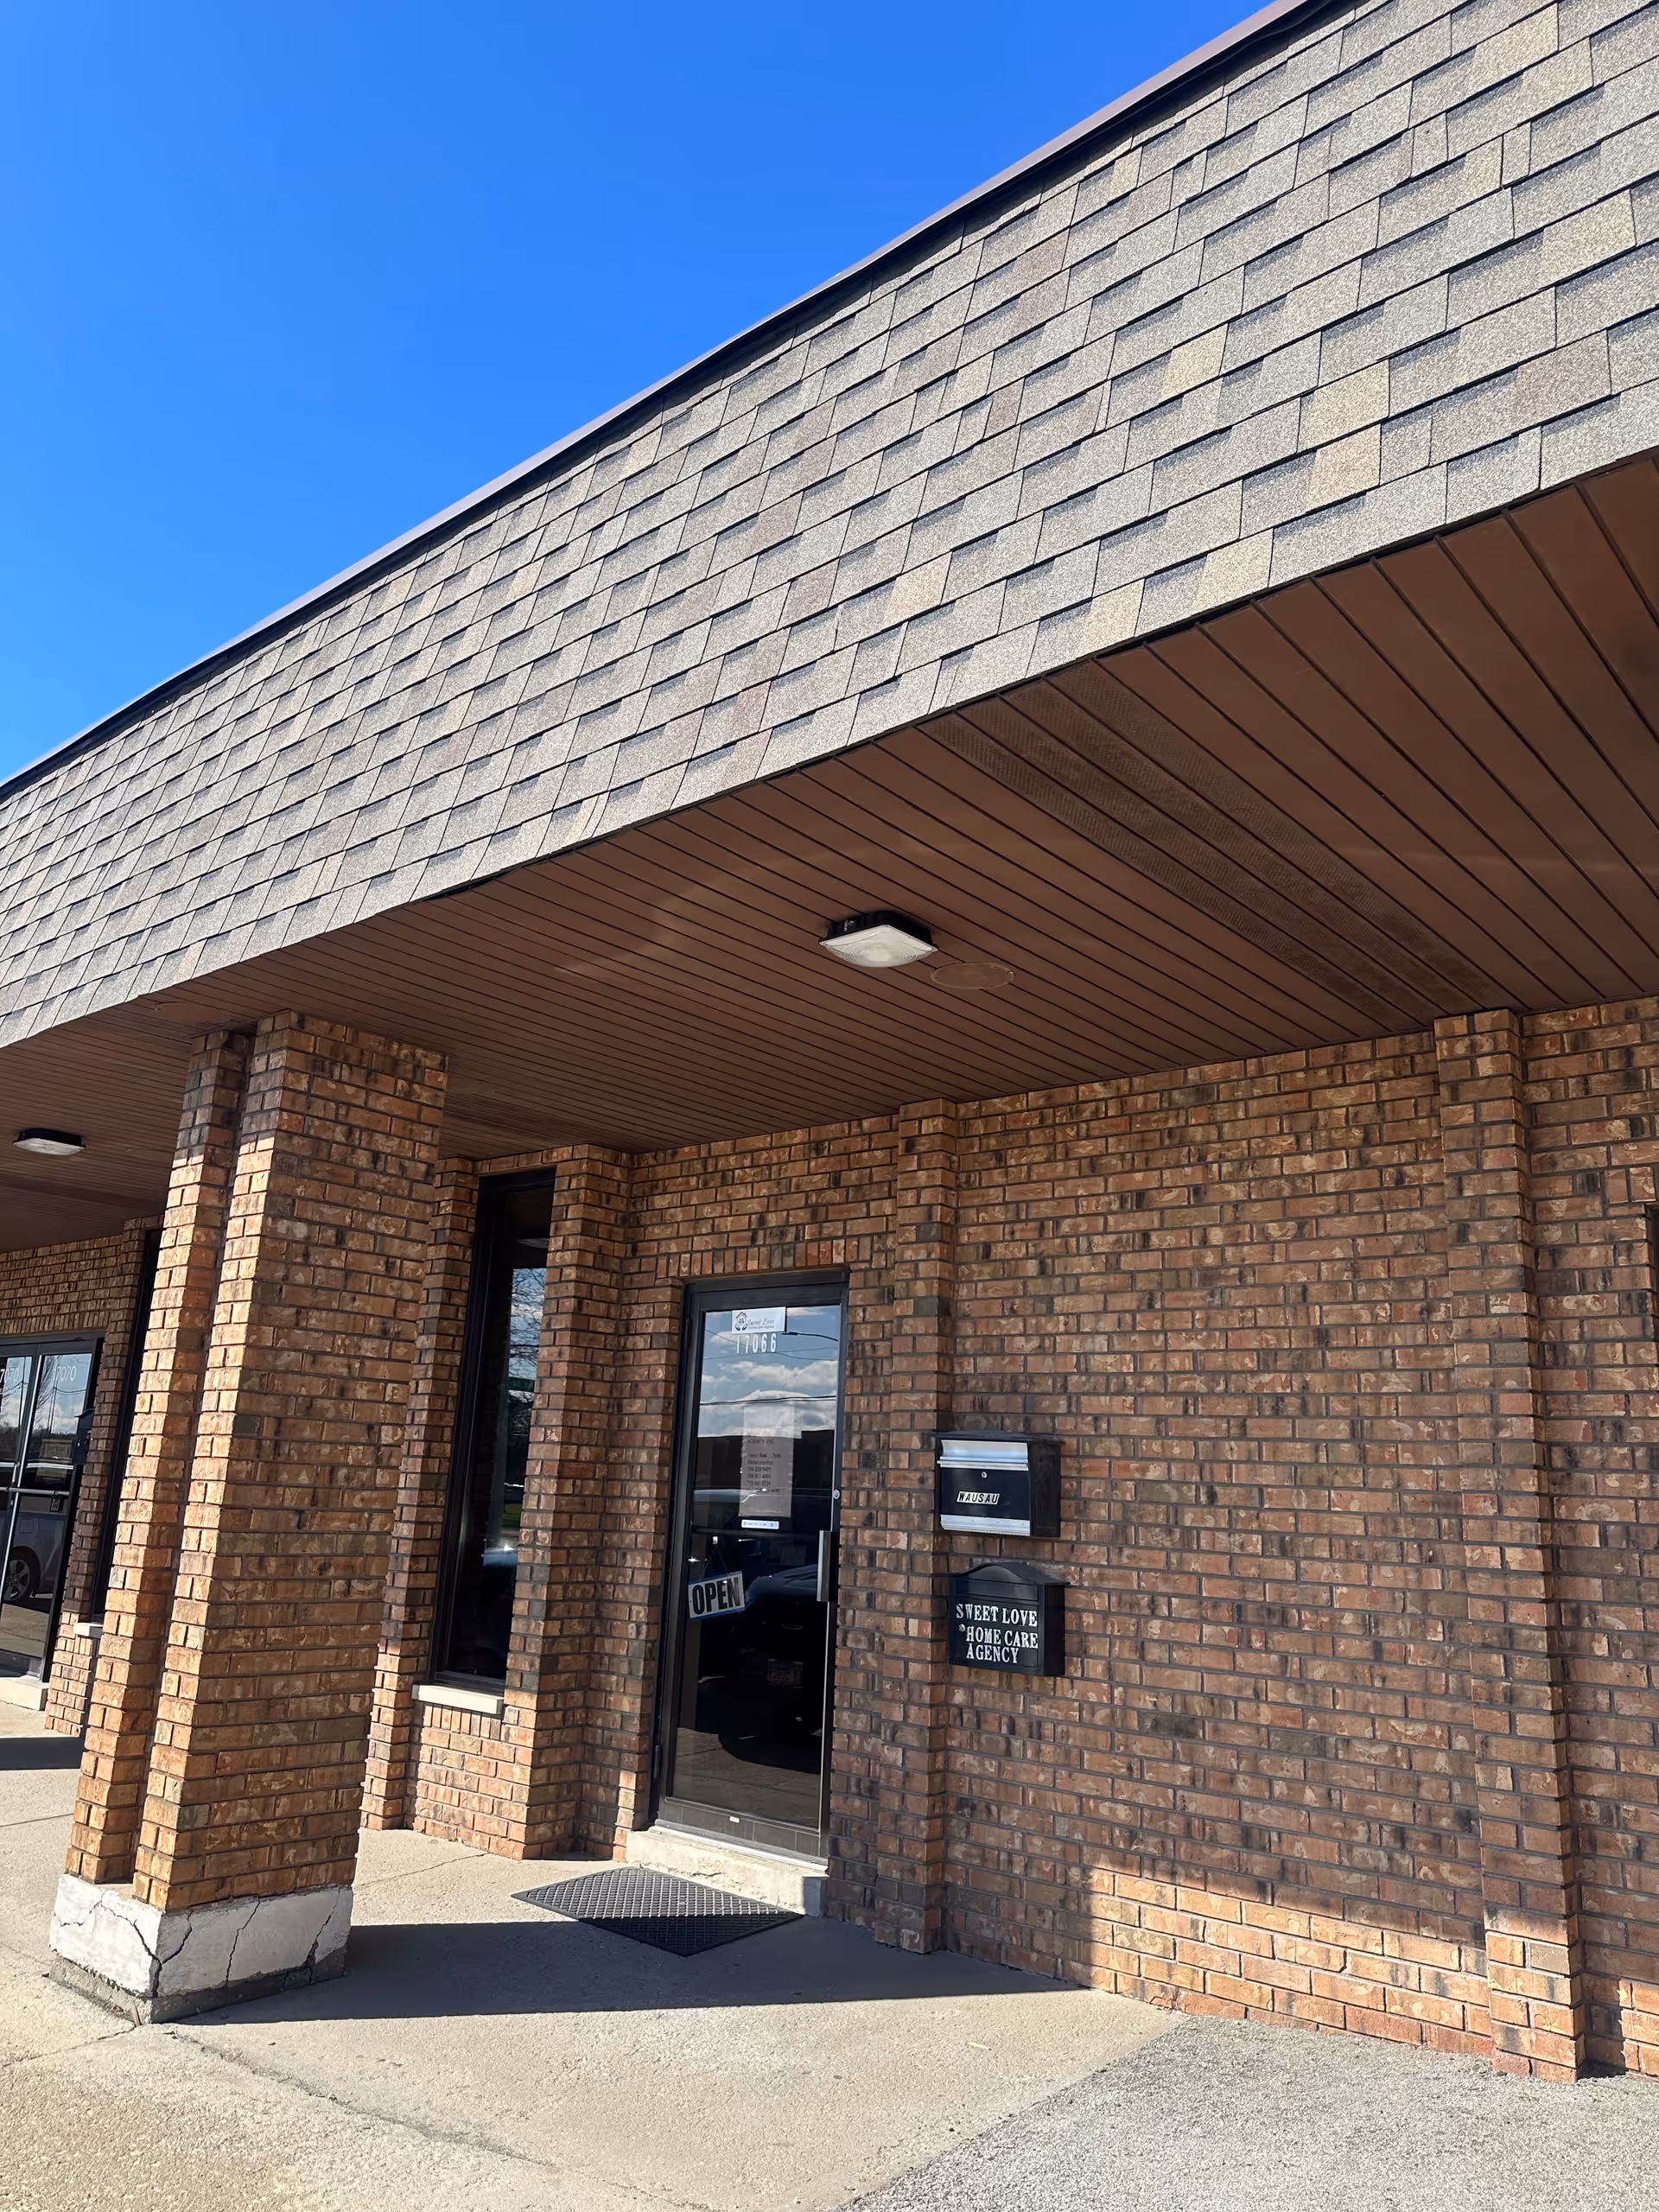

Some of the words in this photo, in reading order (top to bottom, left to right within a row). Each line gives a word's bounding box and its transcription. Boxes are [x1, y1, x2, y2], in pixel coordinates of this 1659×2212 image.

[736, 1333, 777, 1354] 17066
[958, 1492, 999, 1503] WAUSAU
[692, 1577, 741, 1615] OPEN
[956, 1604, 999, 1622] SWEET
[1002, 1608, 1038, 1627] LOVE
[966, 1626, 1001, 1645] HOME
[1004, 1630, 1039, 1649] CARE
[966, 1643, 1020, 1664] AGENCY
